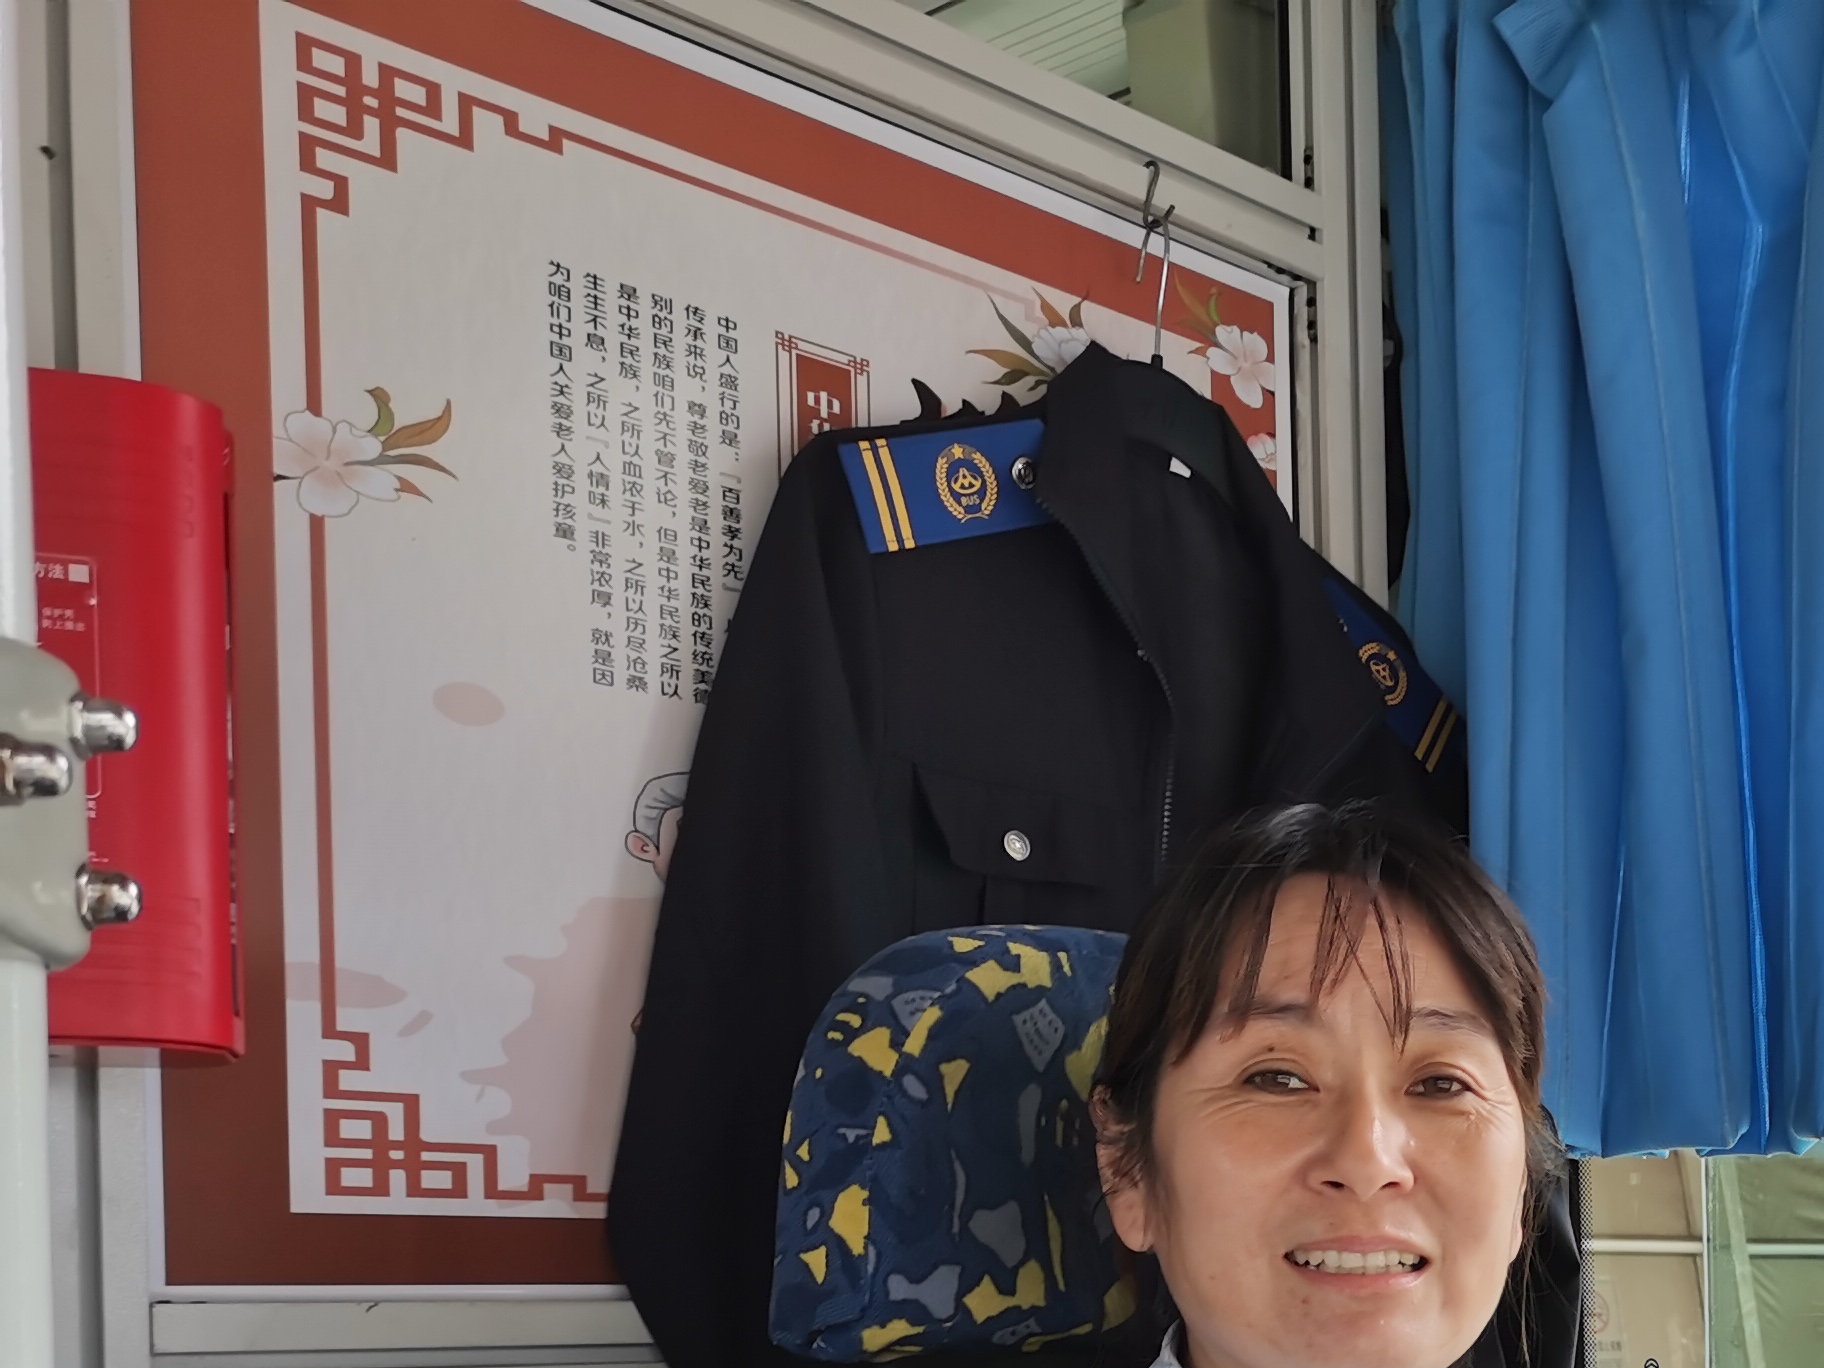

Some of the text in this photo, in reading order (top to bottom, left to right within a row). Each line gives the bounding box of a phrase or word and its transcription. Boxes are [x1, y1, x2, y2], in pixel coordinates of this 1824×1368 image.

[548, 259, 577, 553] 为咱们中国人关爱老人爱护孩童。
